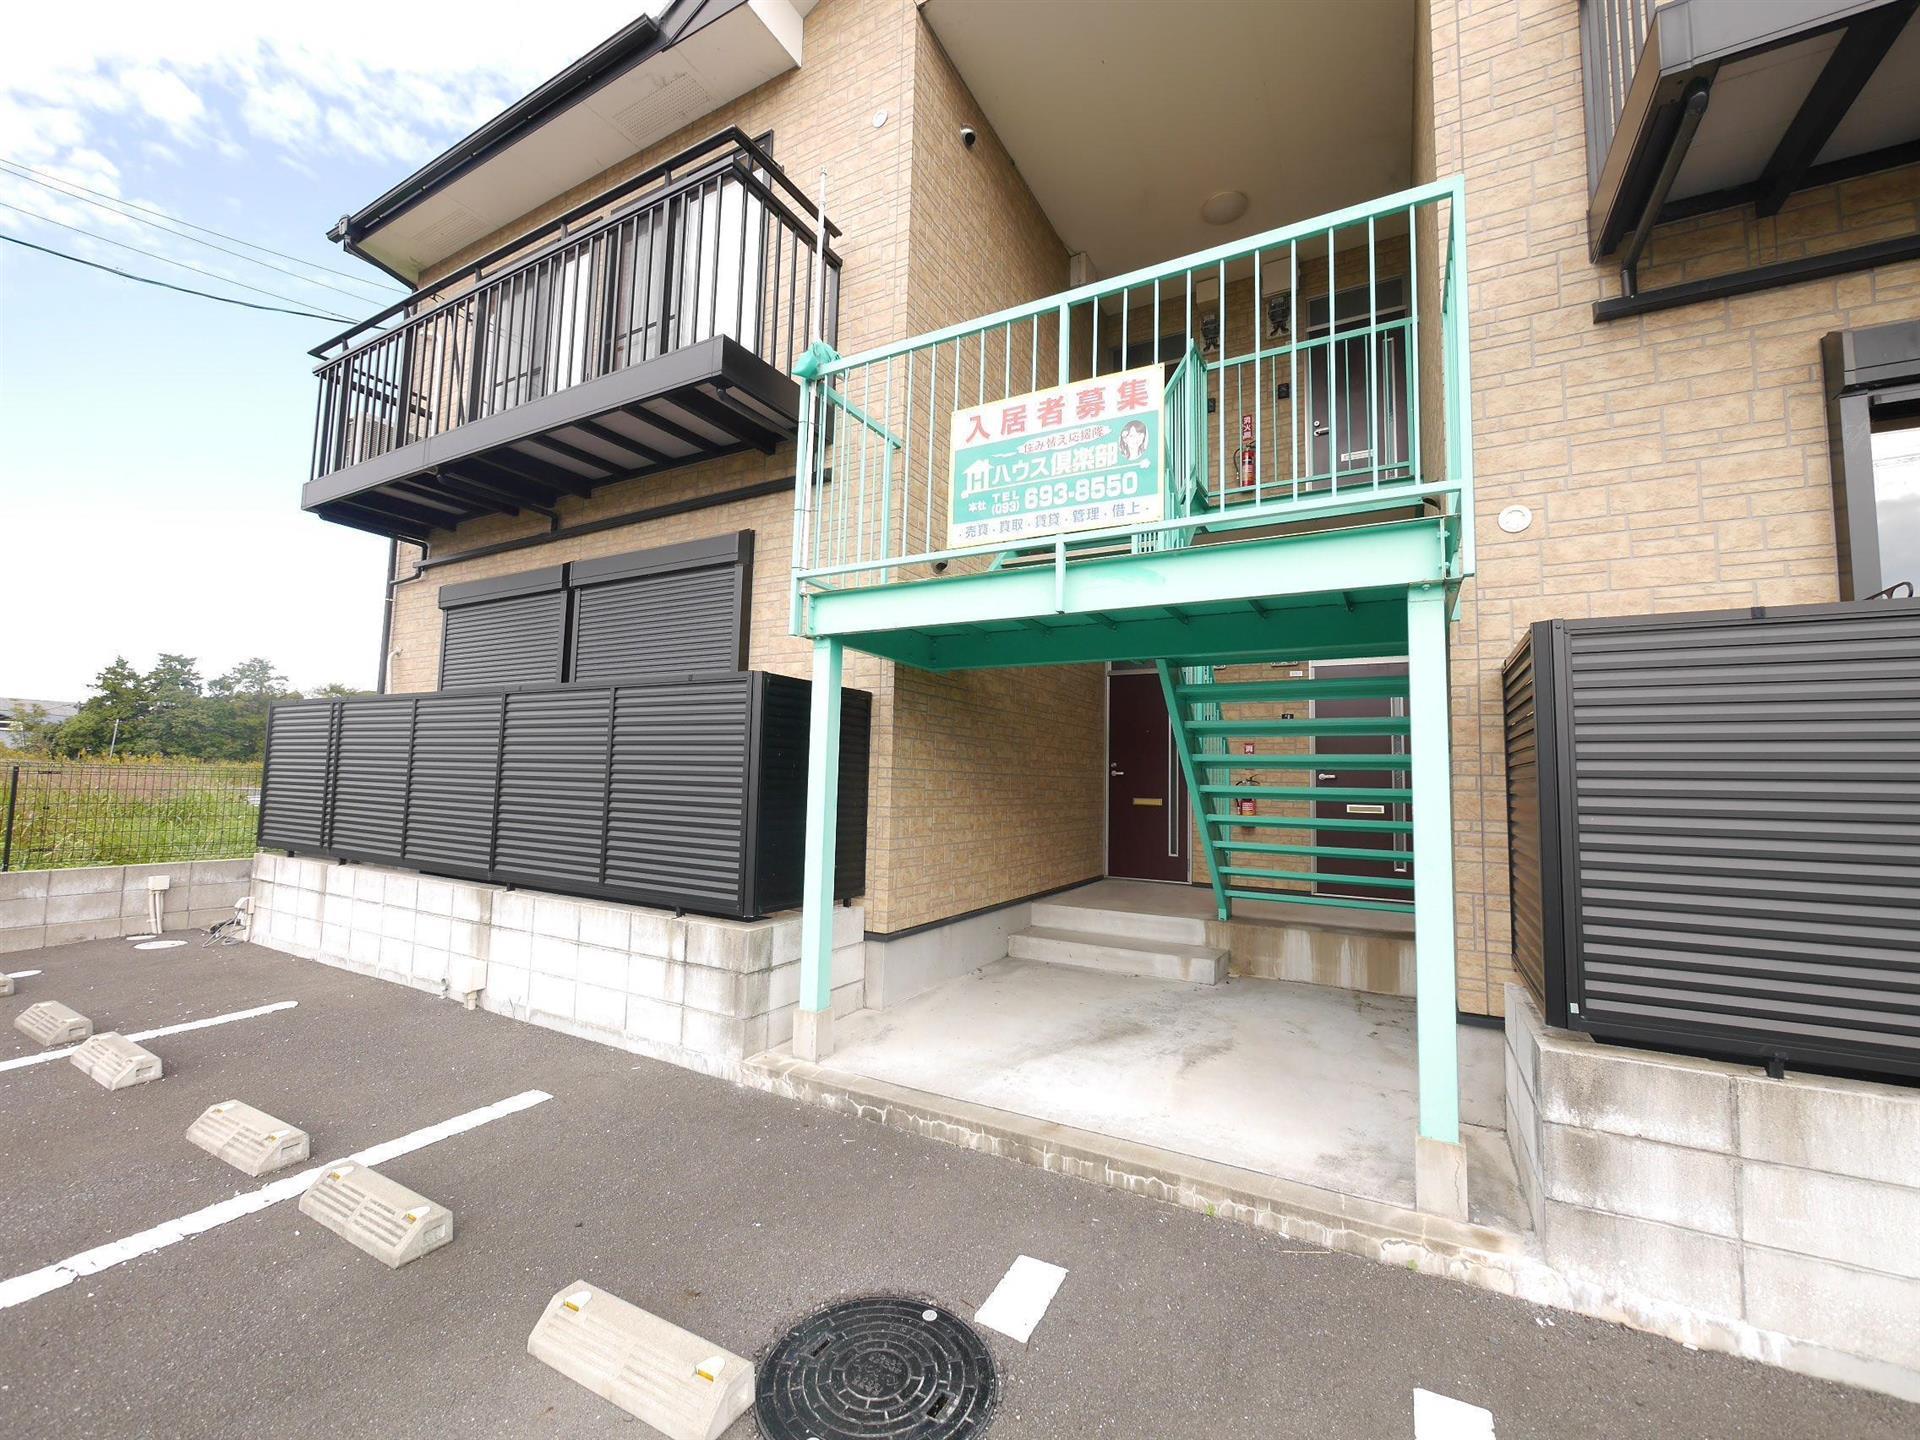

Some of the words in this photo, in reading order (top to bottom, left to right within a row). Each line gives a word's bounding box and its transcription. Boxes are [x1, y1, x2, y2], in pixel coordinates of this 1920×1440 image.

[965, 379, 1149, 443] 入居者募集
[991, 490, 1020, 504] TEL
[1024, 471, 1138, 510] 693-8550
